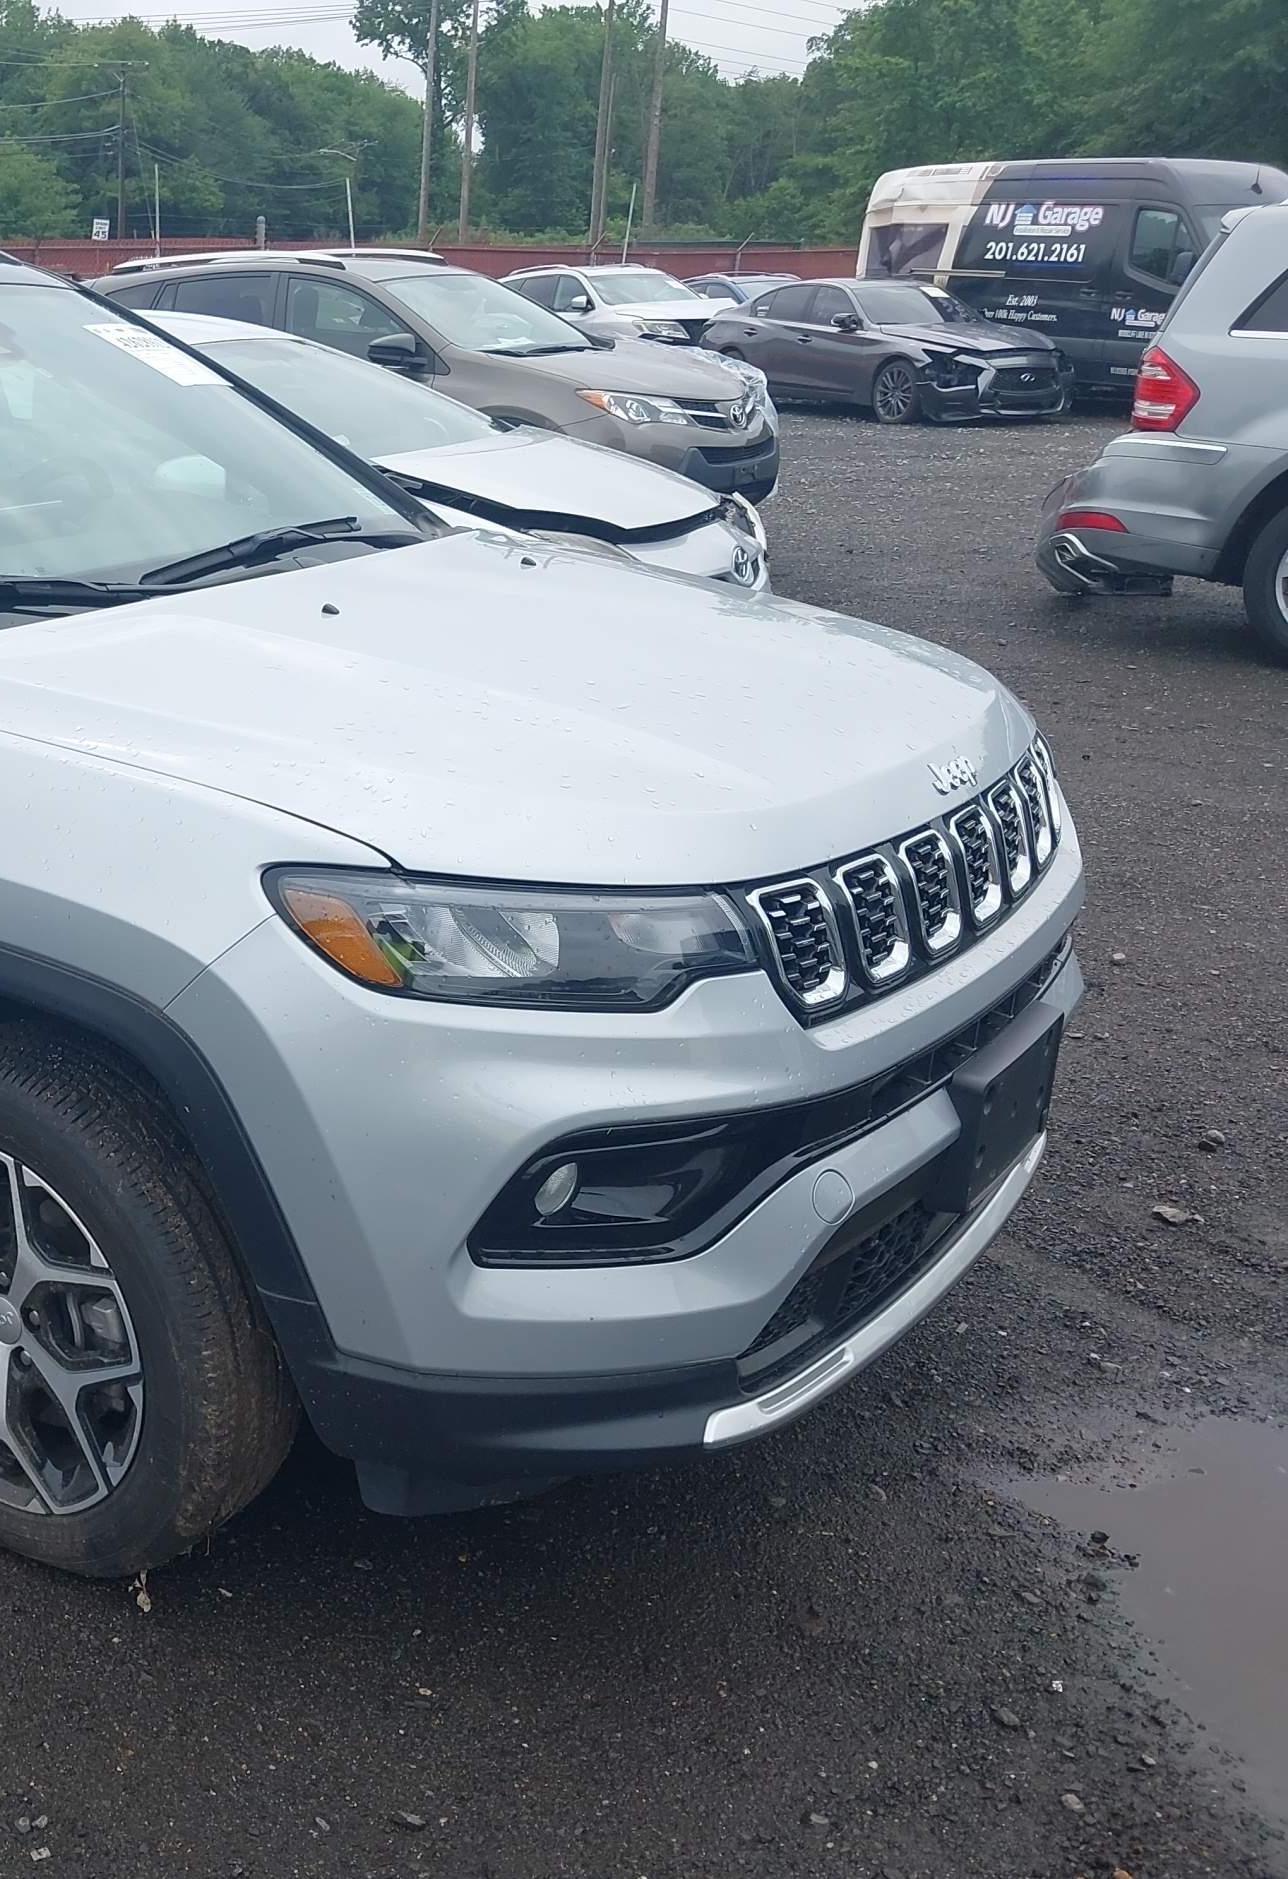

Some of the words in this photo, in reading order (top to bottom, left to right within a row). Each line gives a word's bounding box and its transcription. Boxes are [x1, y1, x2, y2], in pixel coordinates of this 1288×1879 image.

[985, 202, 1016, 229] NJ
[1038, 201, 1103, 231] Garage
[94, 230, 107, 239] 45
[984, 241, 1086, 262] 201.621.2161
[1008, 309, 1027, 322] Happy
[1110, 307, 1126, 321] NJ
[1137, 309, 1166, 325] Garag
[927, 755, 977, 796] Jeep
